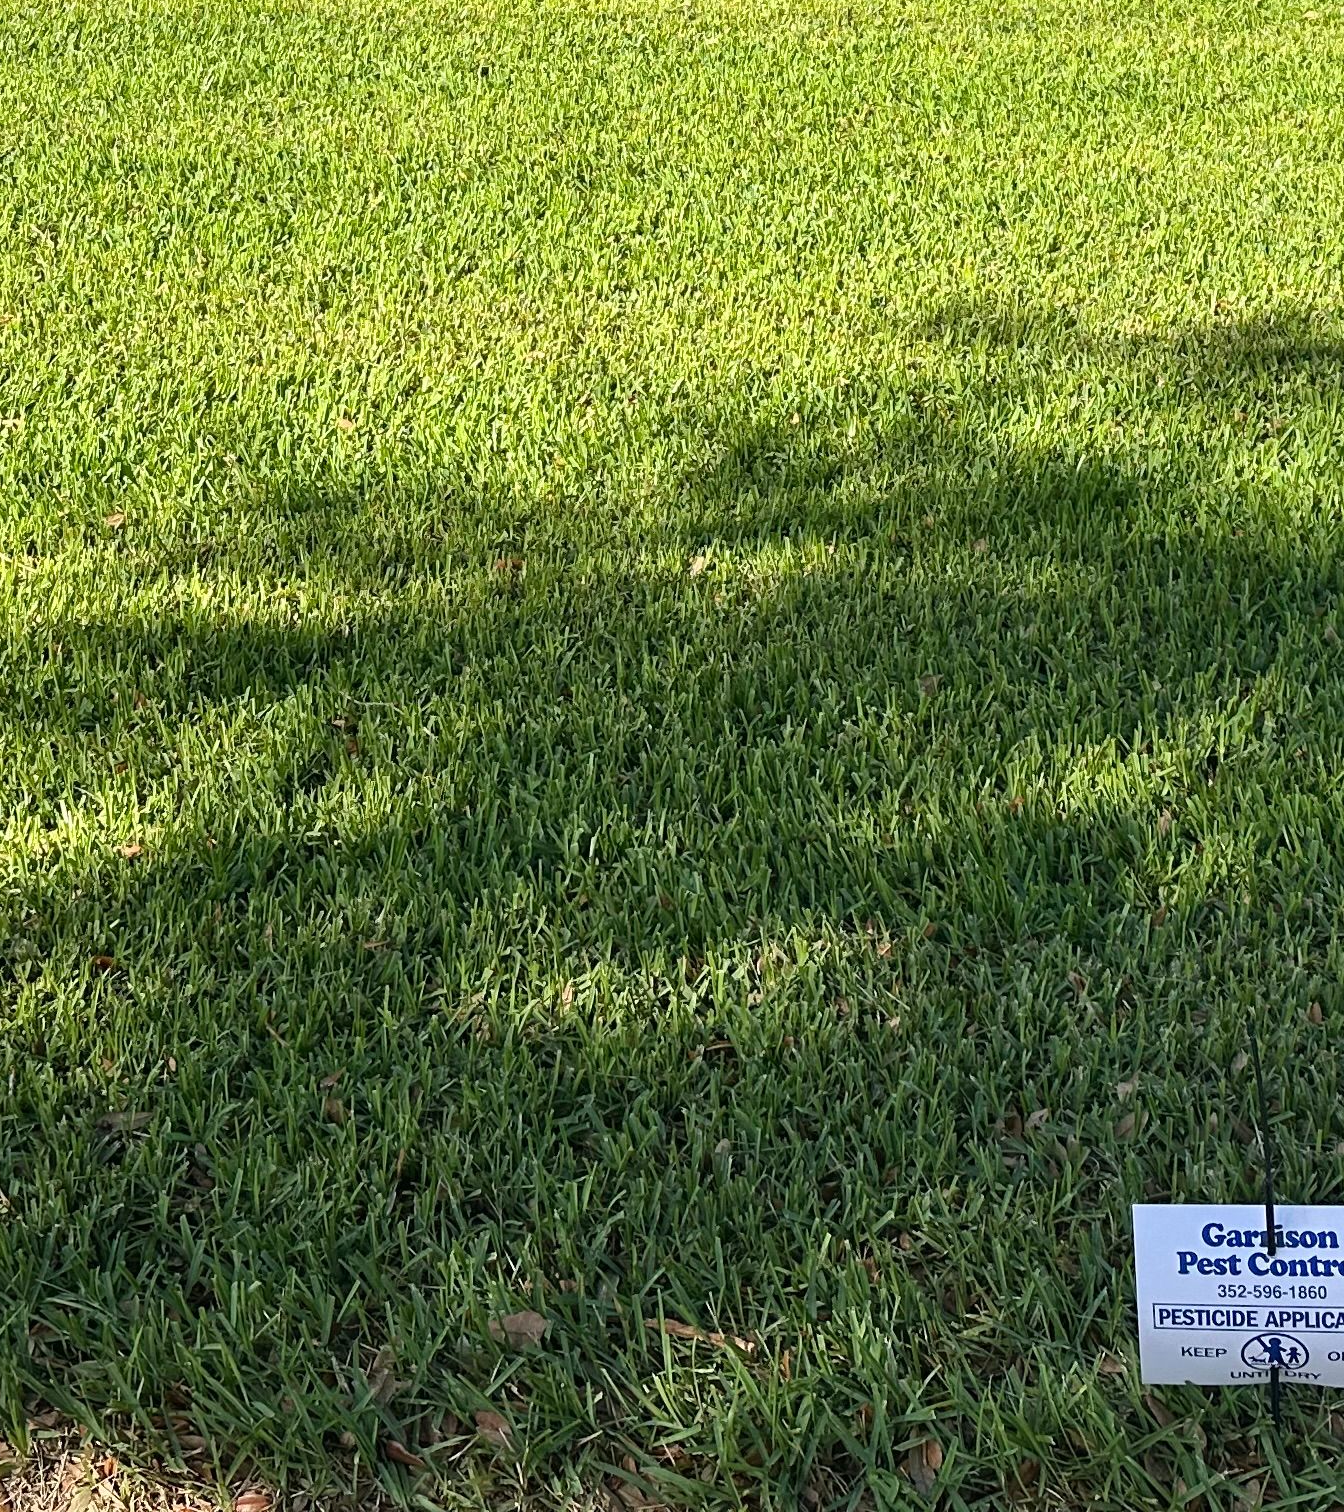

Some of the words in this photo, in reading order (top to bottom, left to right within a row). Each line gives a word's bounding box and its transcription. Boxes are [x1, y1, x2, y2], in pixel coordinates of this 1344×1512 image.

[1177, 1251, 1241, 1276] Pest
[1217, 1285, 1327, 1300] 352-596-1860
[1158, 1308, 1258, 1328] PESTICIDE
[1181, 1346, 1227, 1358] KEEP
[1230, 1370, 1272, 1379] UNTI
[1284, 1370, 1321, 1380] DRY
